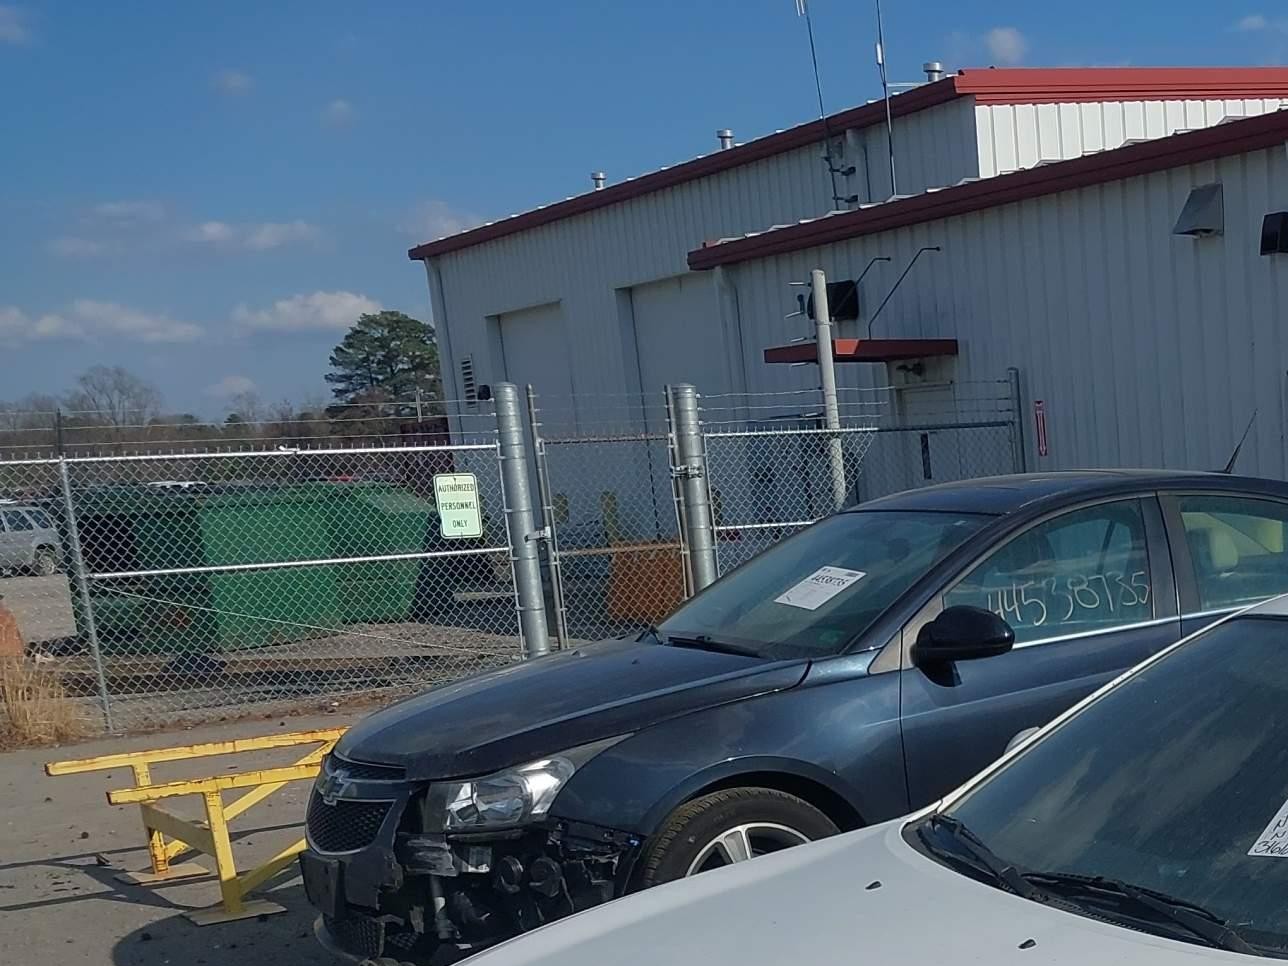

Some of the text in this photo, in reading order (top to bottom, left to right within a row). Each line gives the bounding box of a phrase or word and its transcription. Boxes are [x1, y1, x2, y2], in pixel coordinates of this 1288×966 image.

[438, 483, 475, 493] AUTHORIZED
[441, 501, 477, 511] PERSONNEL
[452, 519, 468, 528] ONLY
